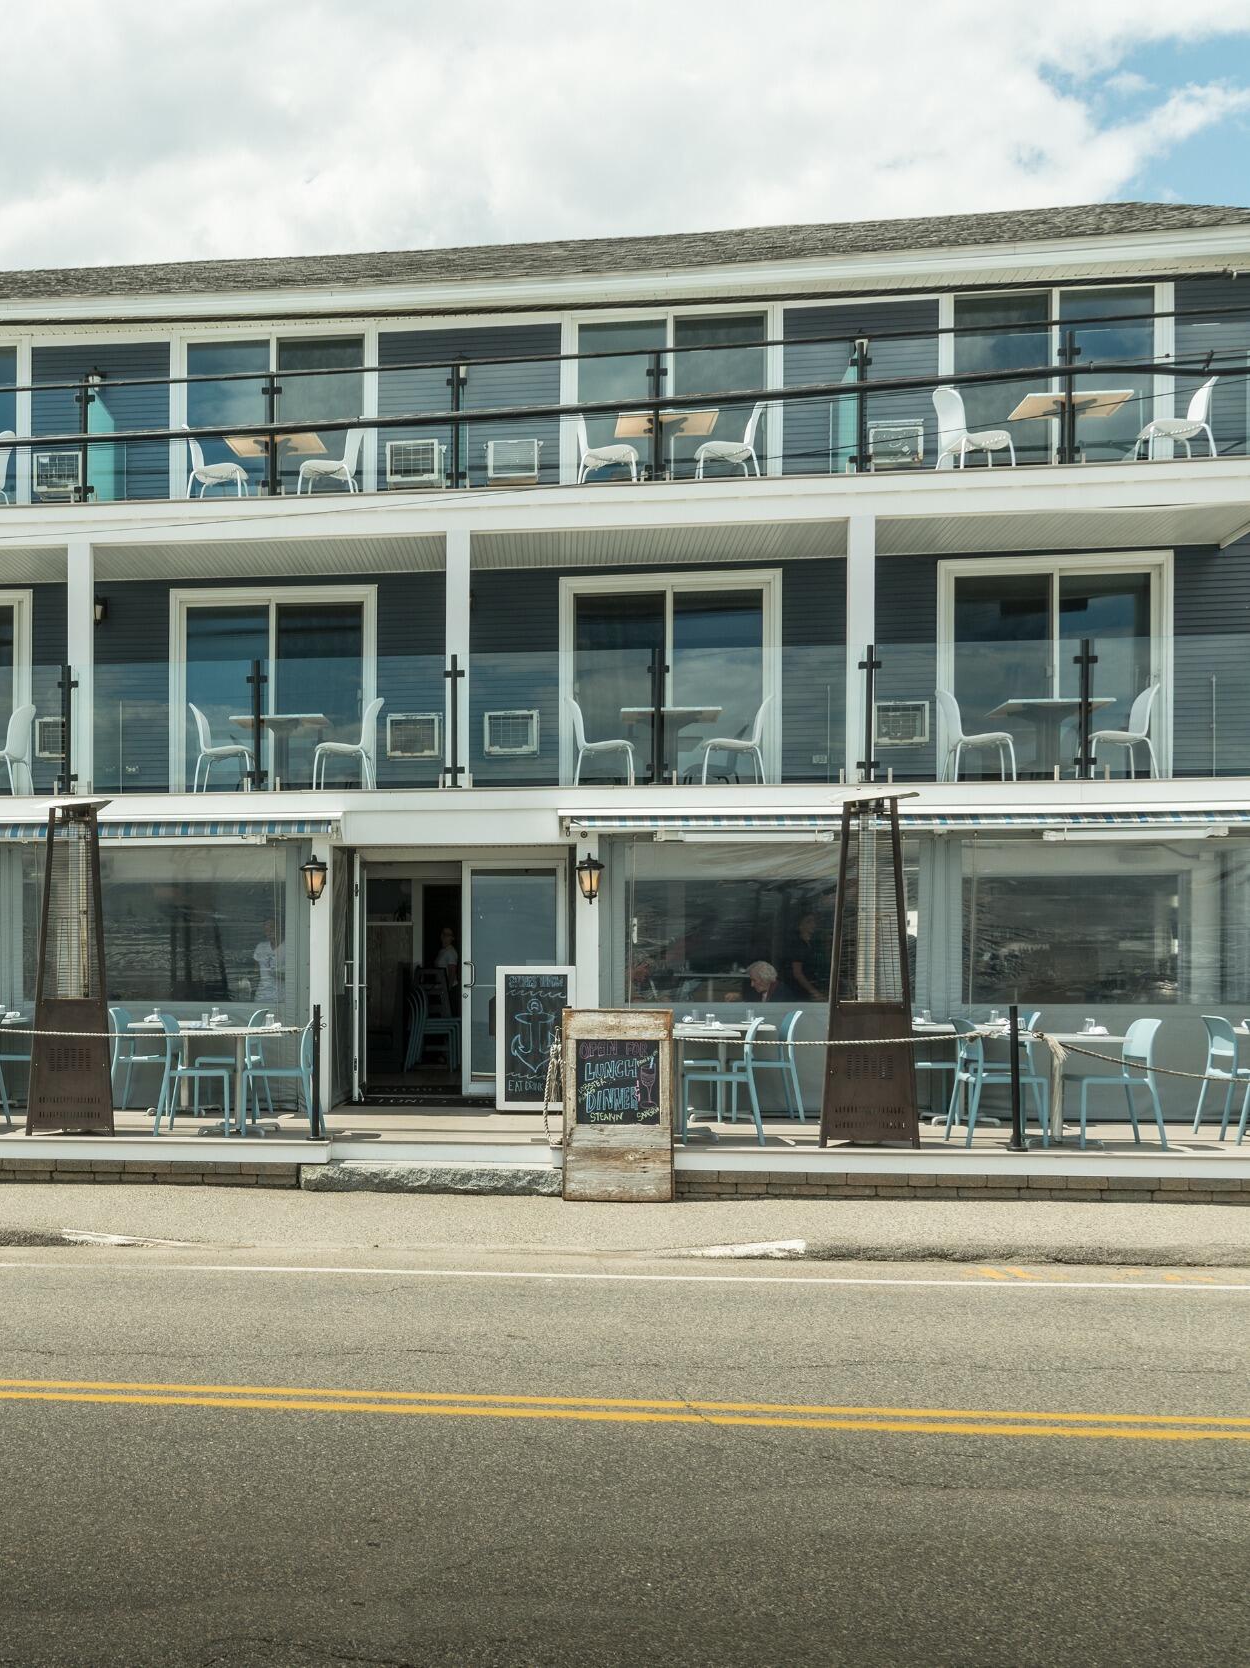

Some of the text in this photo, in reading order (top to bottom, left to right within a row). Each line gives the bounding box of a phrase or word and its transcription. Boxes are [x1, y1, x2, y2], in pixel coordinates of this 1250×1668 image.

[579, 1041, 618, 1060] OPEN
[625, 1041, 649, 1058] FOR
[584, 1058, 638, 1082] LUNCH
[508, 1079, 523, 1092] EAT
[586, 1086, 639, 1114] DINNER
